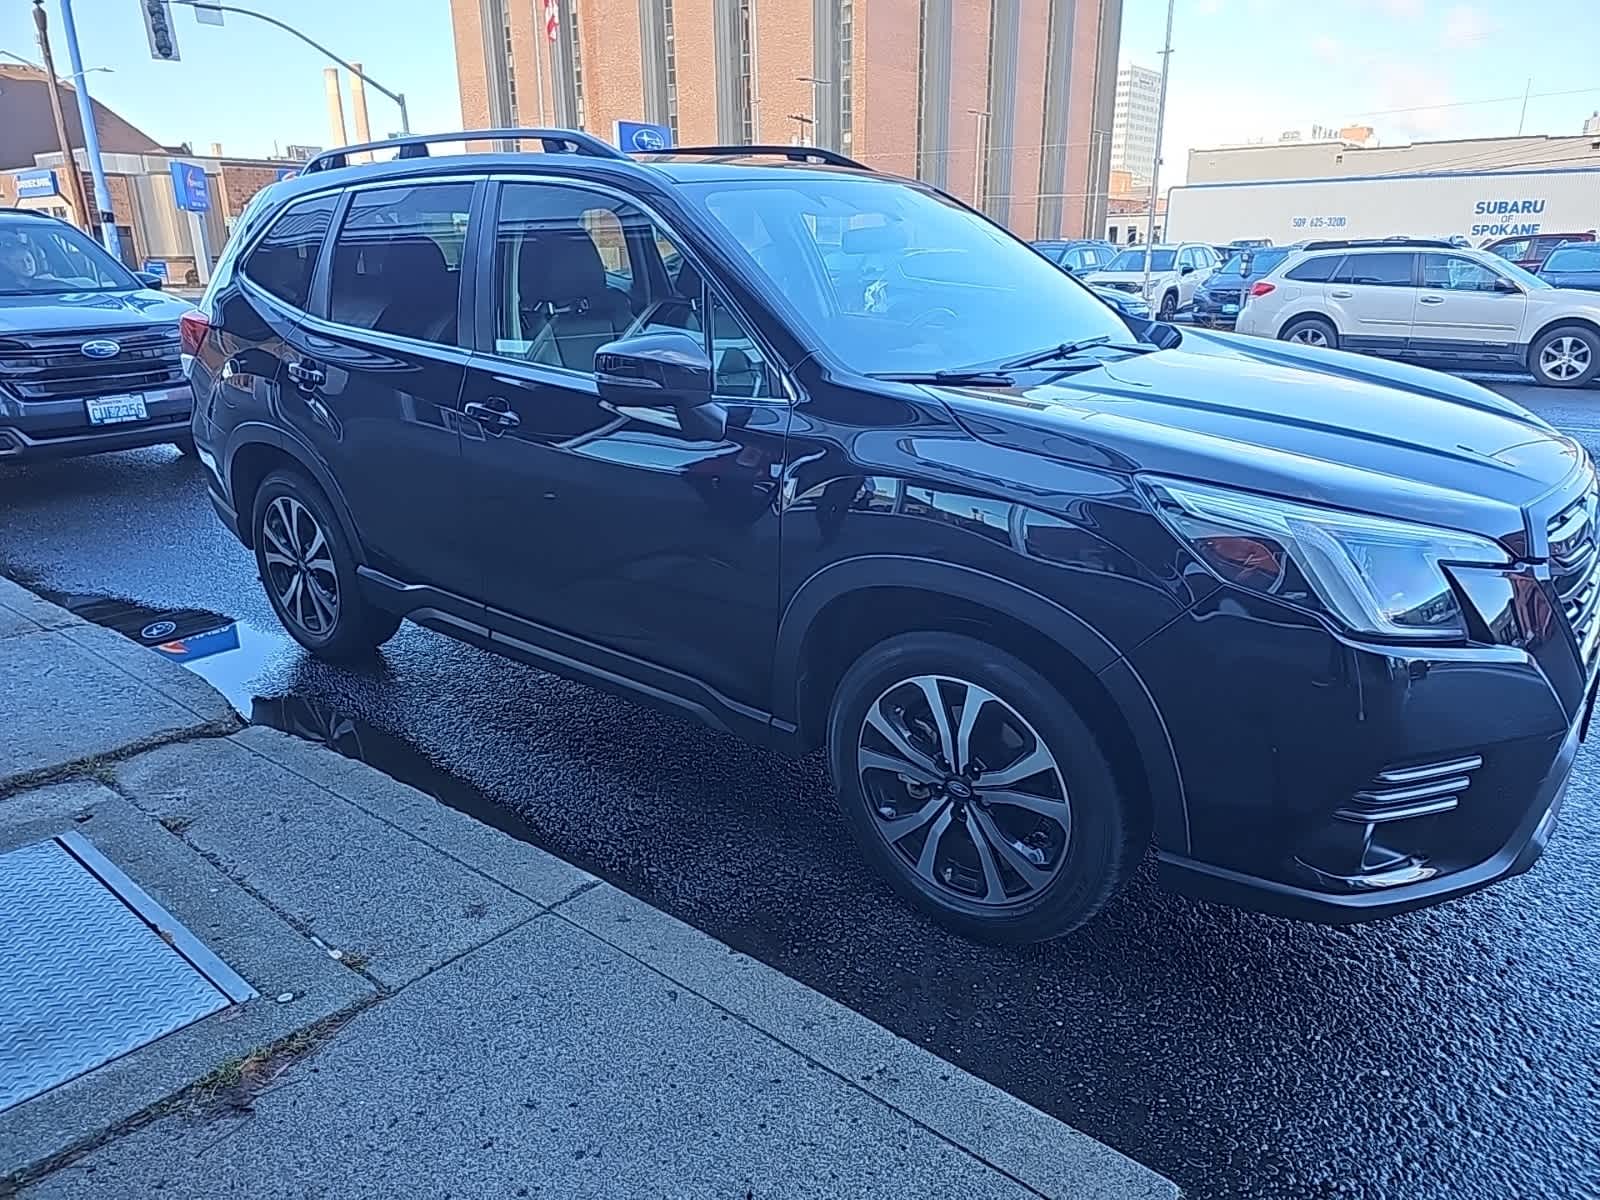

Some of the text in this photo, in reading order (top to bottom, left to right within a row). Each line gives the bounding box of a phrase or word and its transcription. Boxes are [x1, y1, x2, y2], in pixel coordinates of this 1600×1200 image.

[1474, 199, 1546, 214] SUBARU
[1292, 217, 1306, 228] 509
[1500, 214, 1514, 223] OF
[1471, 223, 1541, 236] SPOKANE
